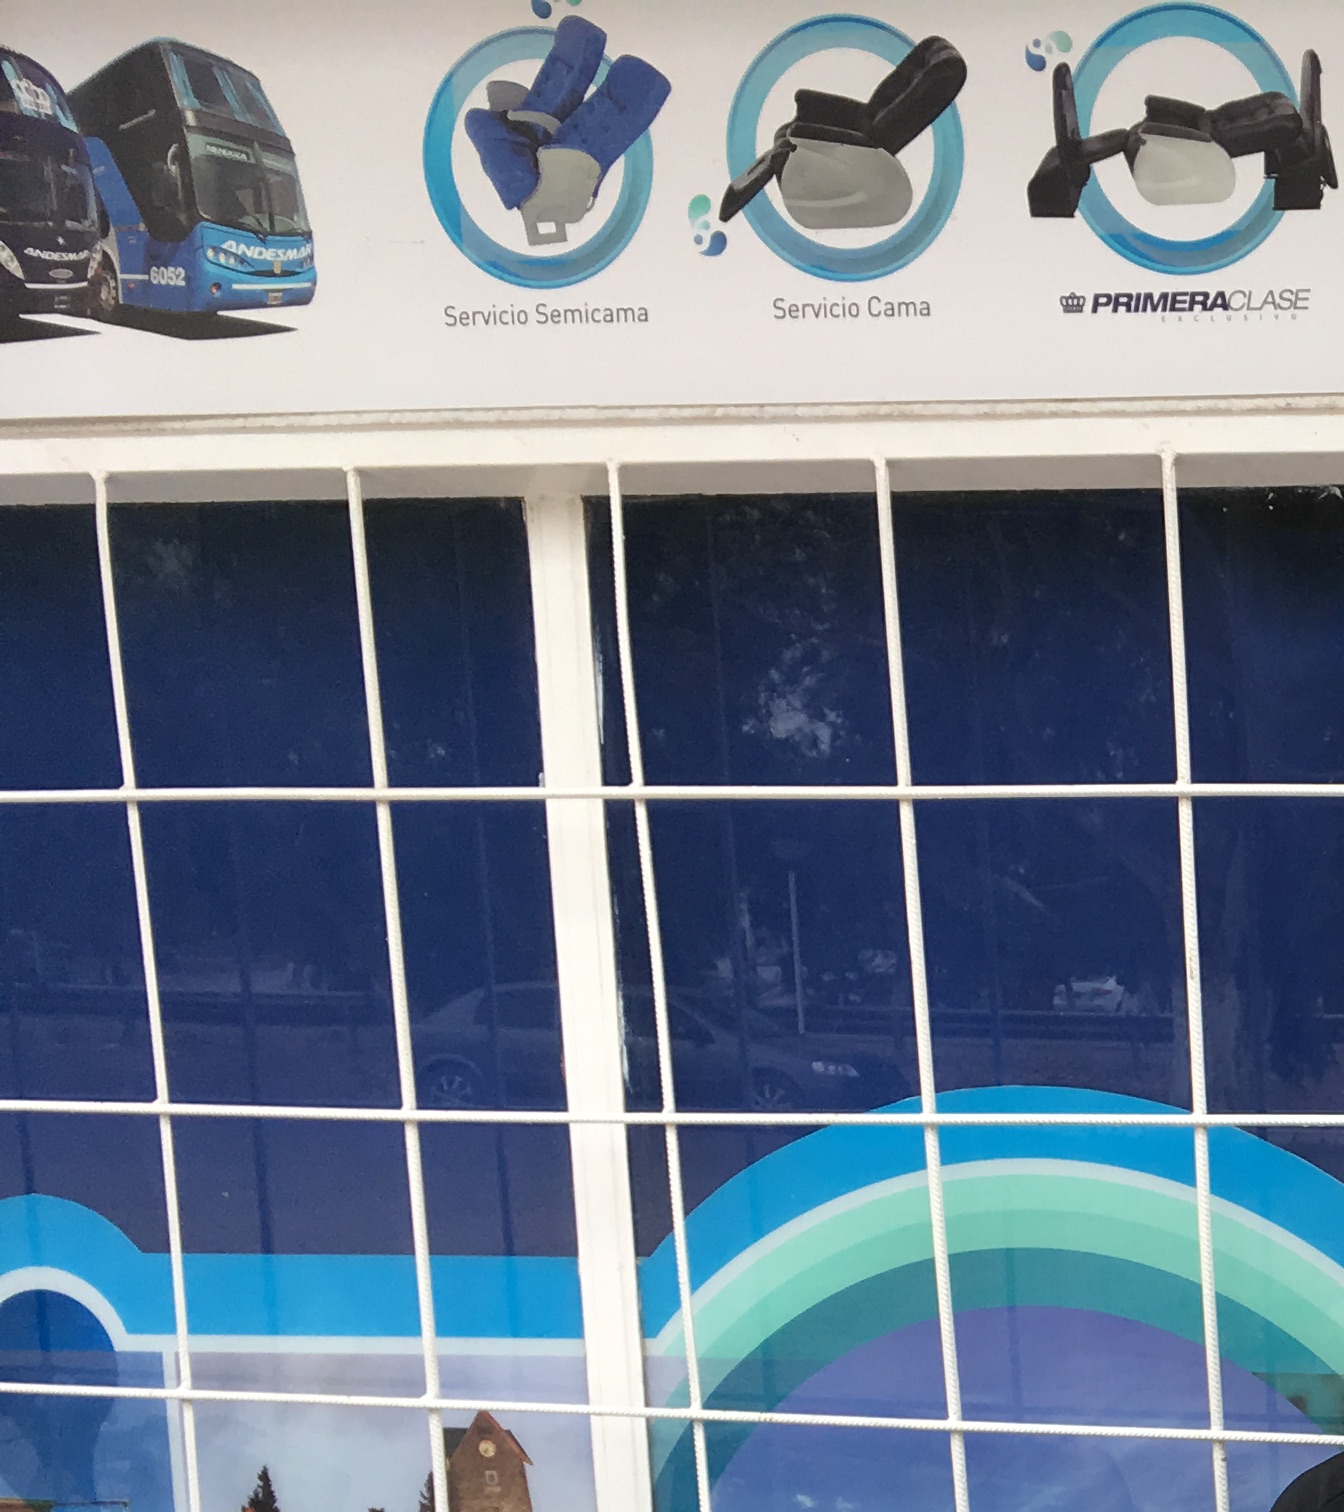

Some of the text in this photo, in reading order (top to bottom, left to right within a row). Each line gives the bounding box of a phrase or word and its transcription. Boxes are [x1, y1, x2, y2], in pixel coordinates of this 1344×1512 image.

[150, 266, 186, 286] 6052
[444, 303, 648, 326] Servicio Semicama
[773, 296, 930, 319] Servicio Cama
